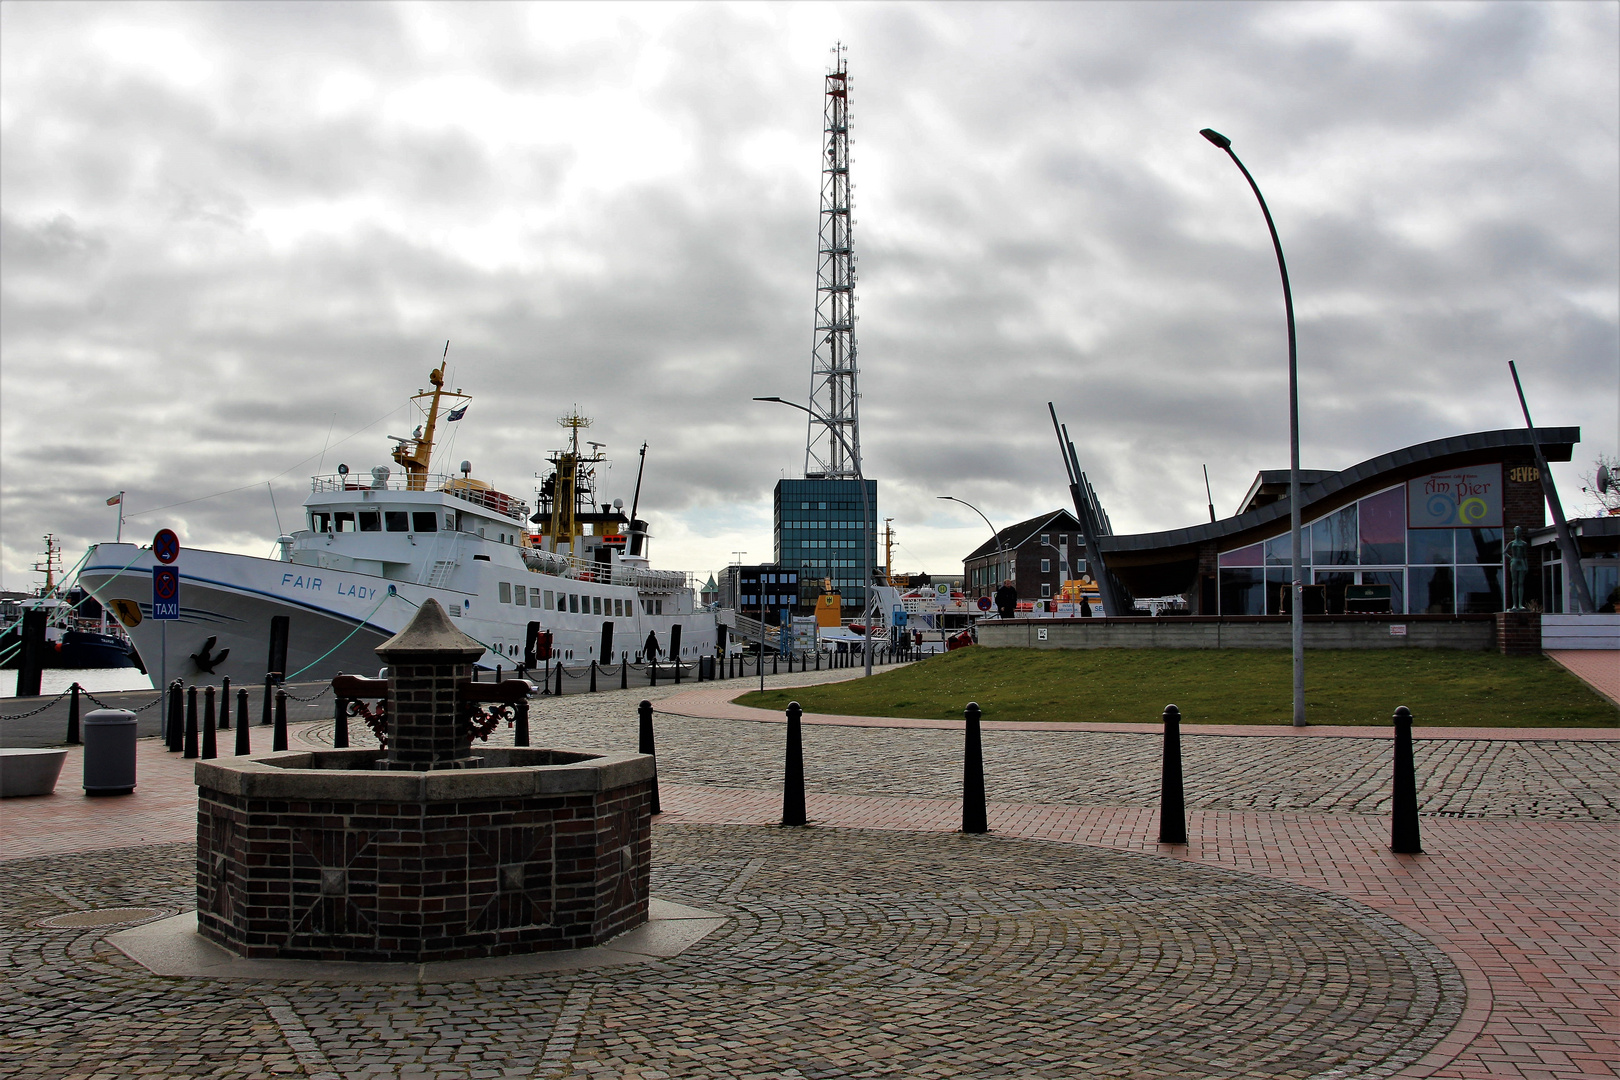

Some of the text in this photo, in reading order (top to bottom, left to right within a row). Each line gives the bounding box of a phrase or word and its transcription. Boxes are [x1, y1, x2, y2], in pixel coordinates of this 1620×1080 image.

[1510, 466, 1540, 482] JEVER
[1424, 479, 1450, 494] Am
[281, 573, 377, 600] FAIR LADY
[155, 603, 177, 615] TAXI
